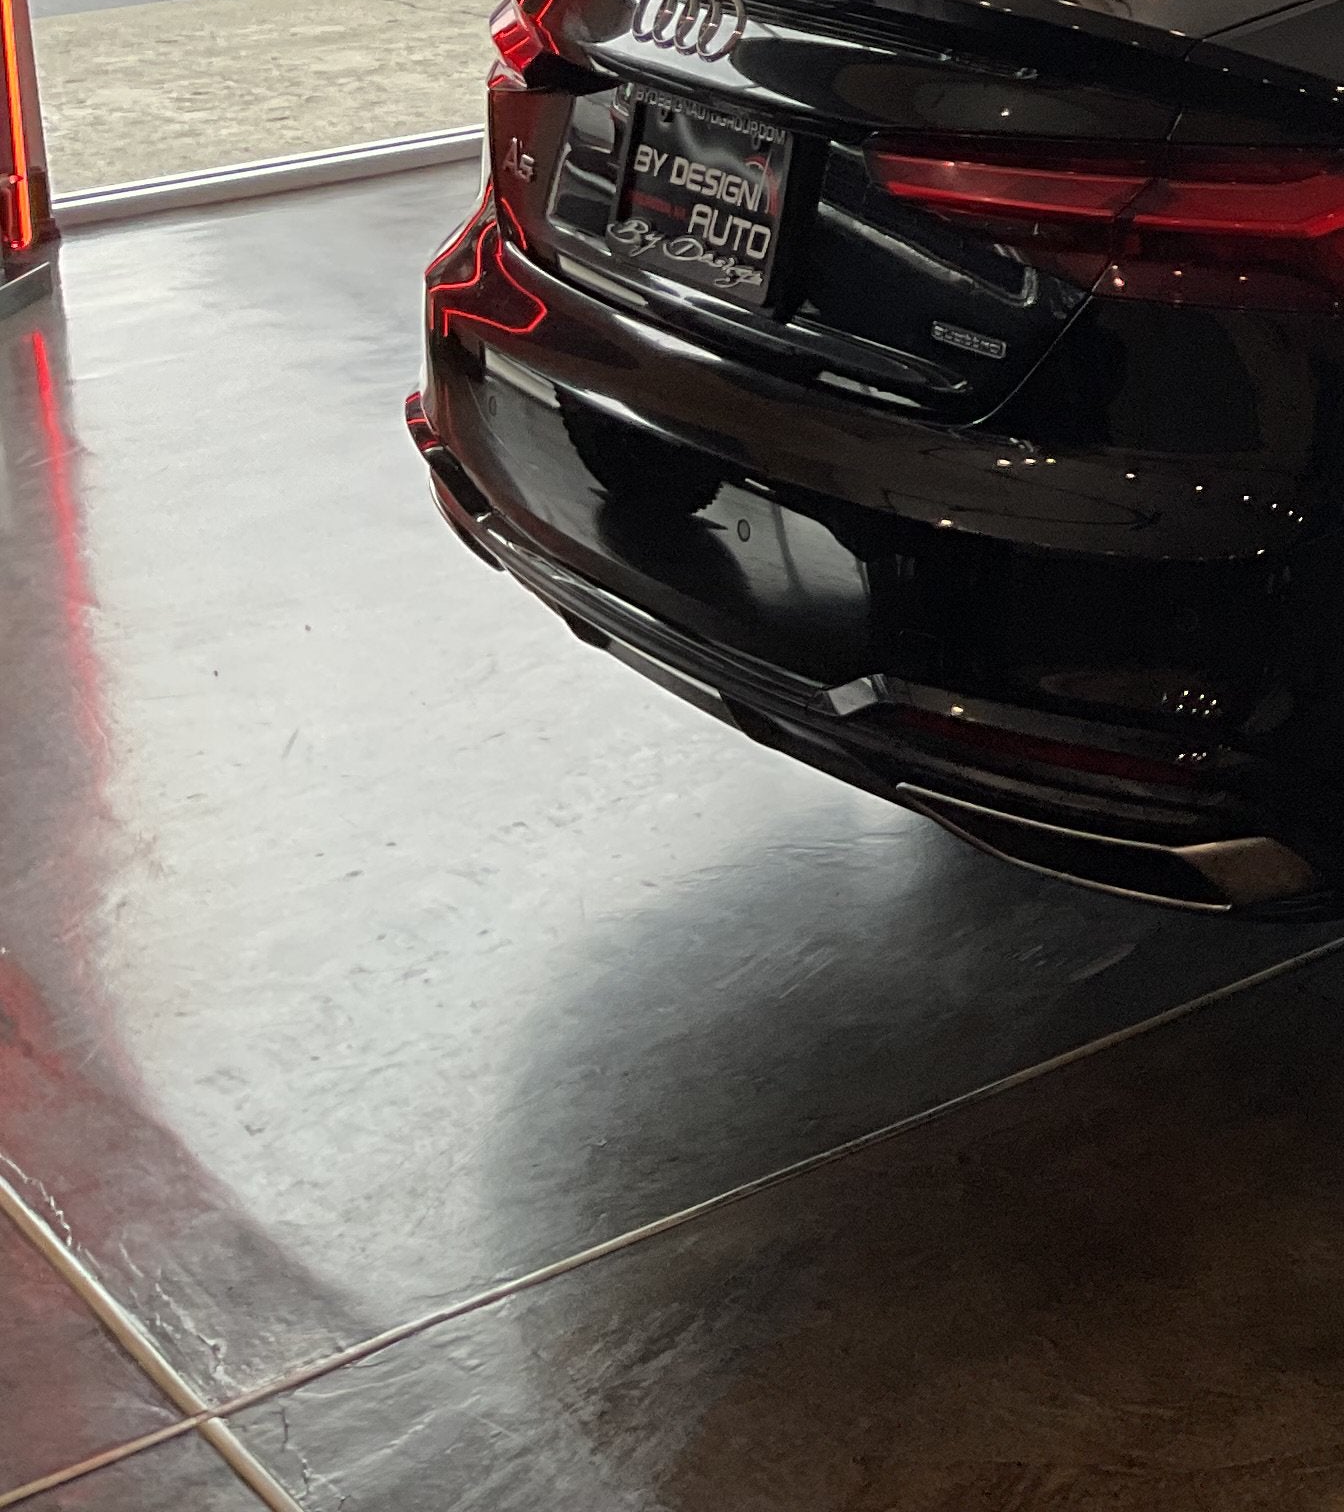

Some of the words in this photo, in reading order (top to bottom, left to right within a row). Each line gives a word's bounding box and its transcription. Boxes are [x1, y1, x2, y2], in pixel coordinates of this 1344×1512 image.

[633, 144, 668, 177] BY
[670, 156, 760, 213] DESIGN
[687, 203, 771, 260] AUTO
